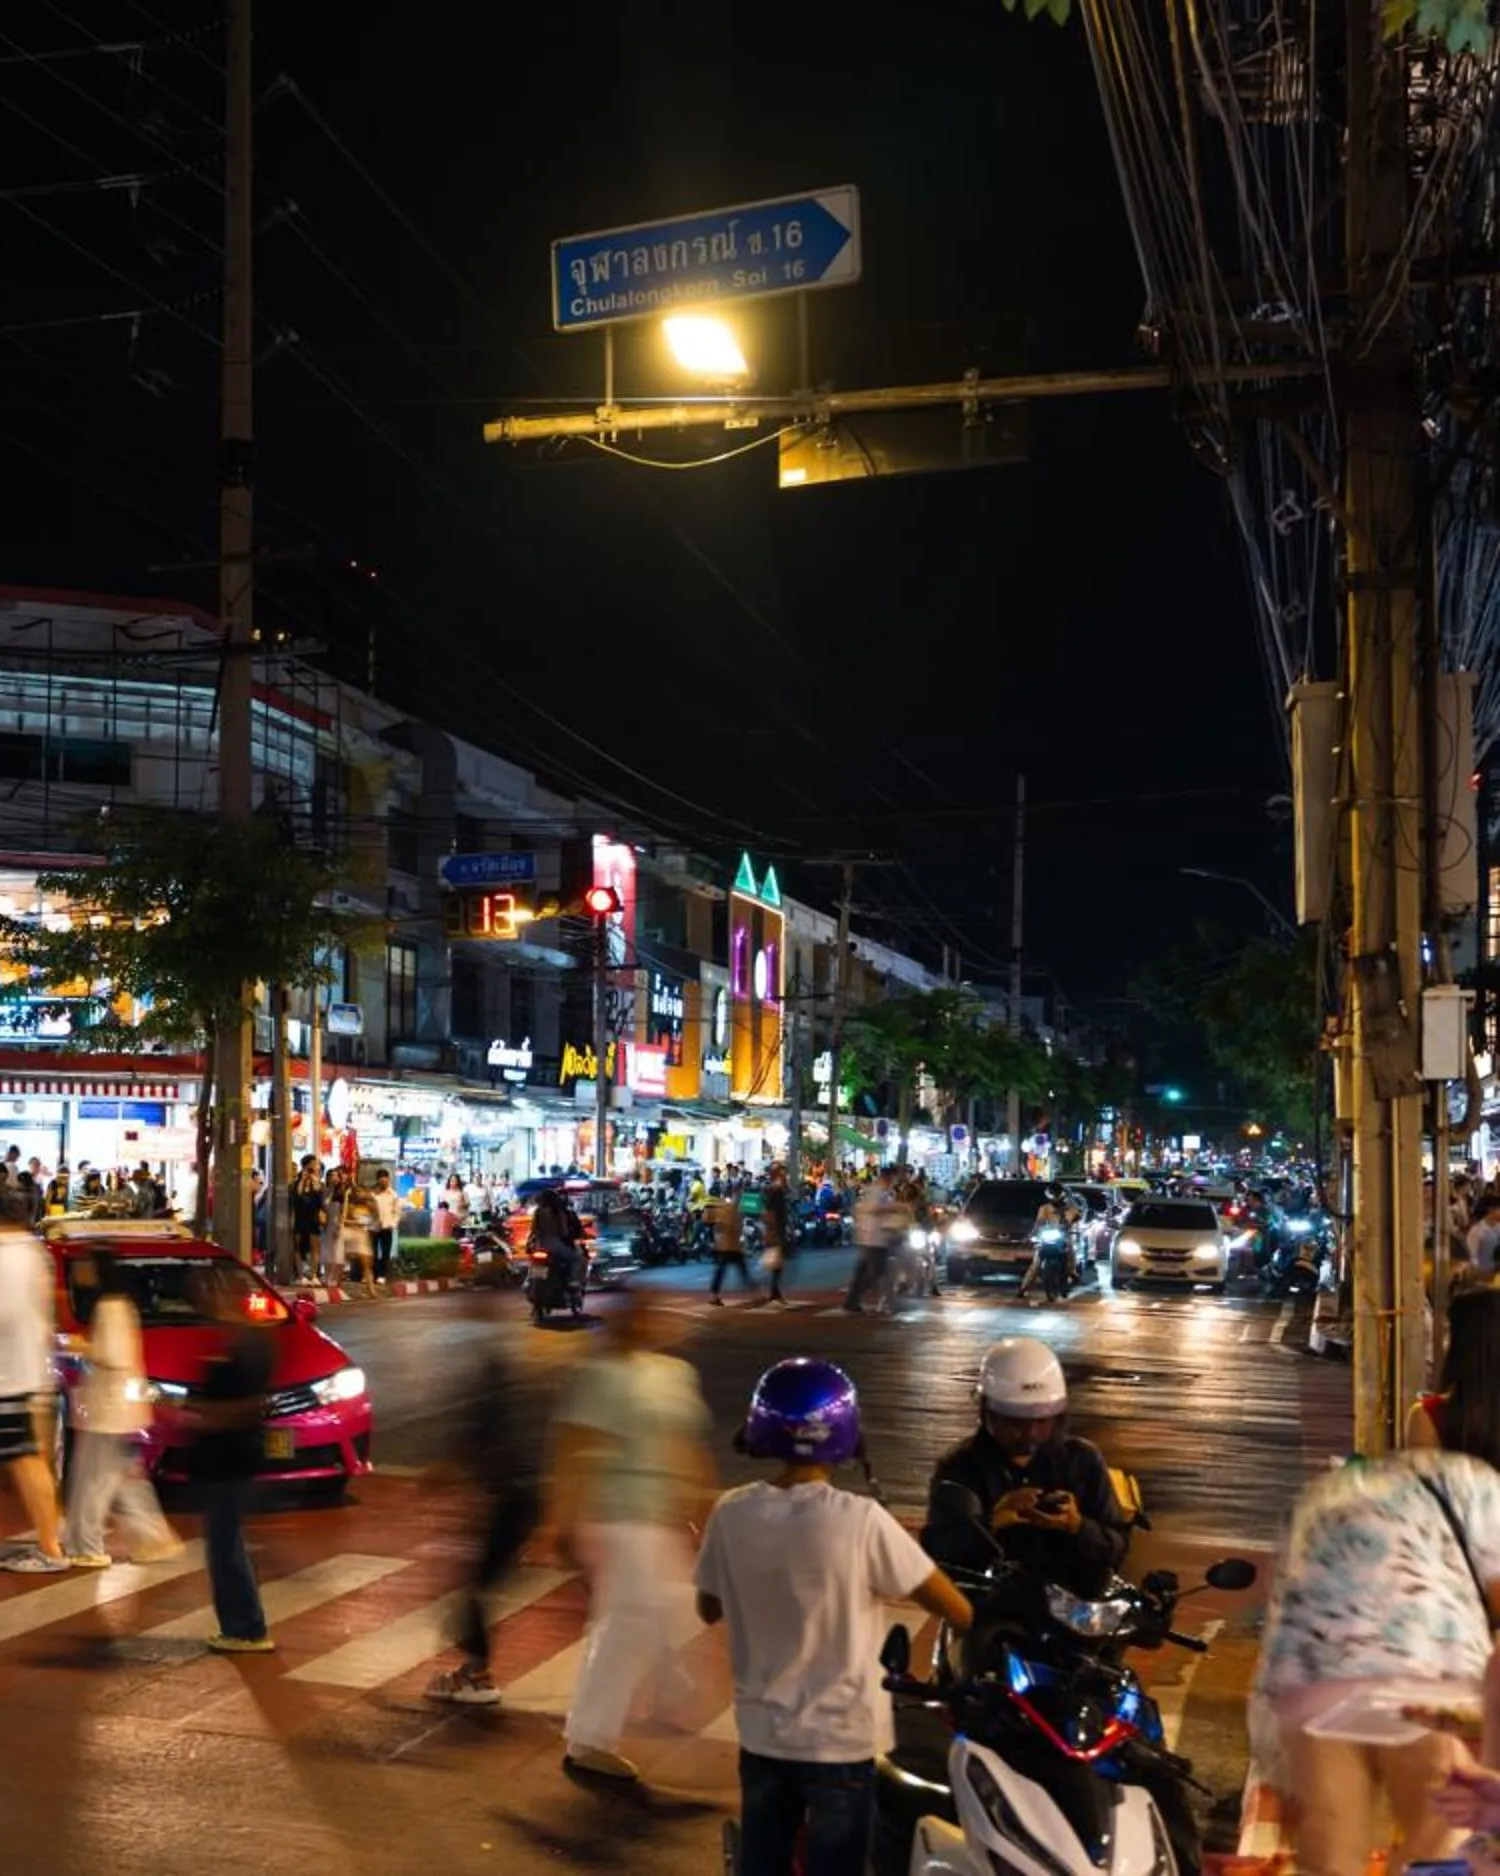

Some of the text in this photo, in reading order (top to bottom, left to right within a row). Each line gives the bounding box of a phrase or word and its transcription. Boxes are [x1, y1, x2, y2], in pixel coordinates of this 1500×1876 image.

[571, 219, 740, 296] จุฬาลงกรณ์
[732, 266, 768, 288] Soi
[782, 258, 805, 279] 16
[483, 893, 515, 934] 13
